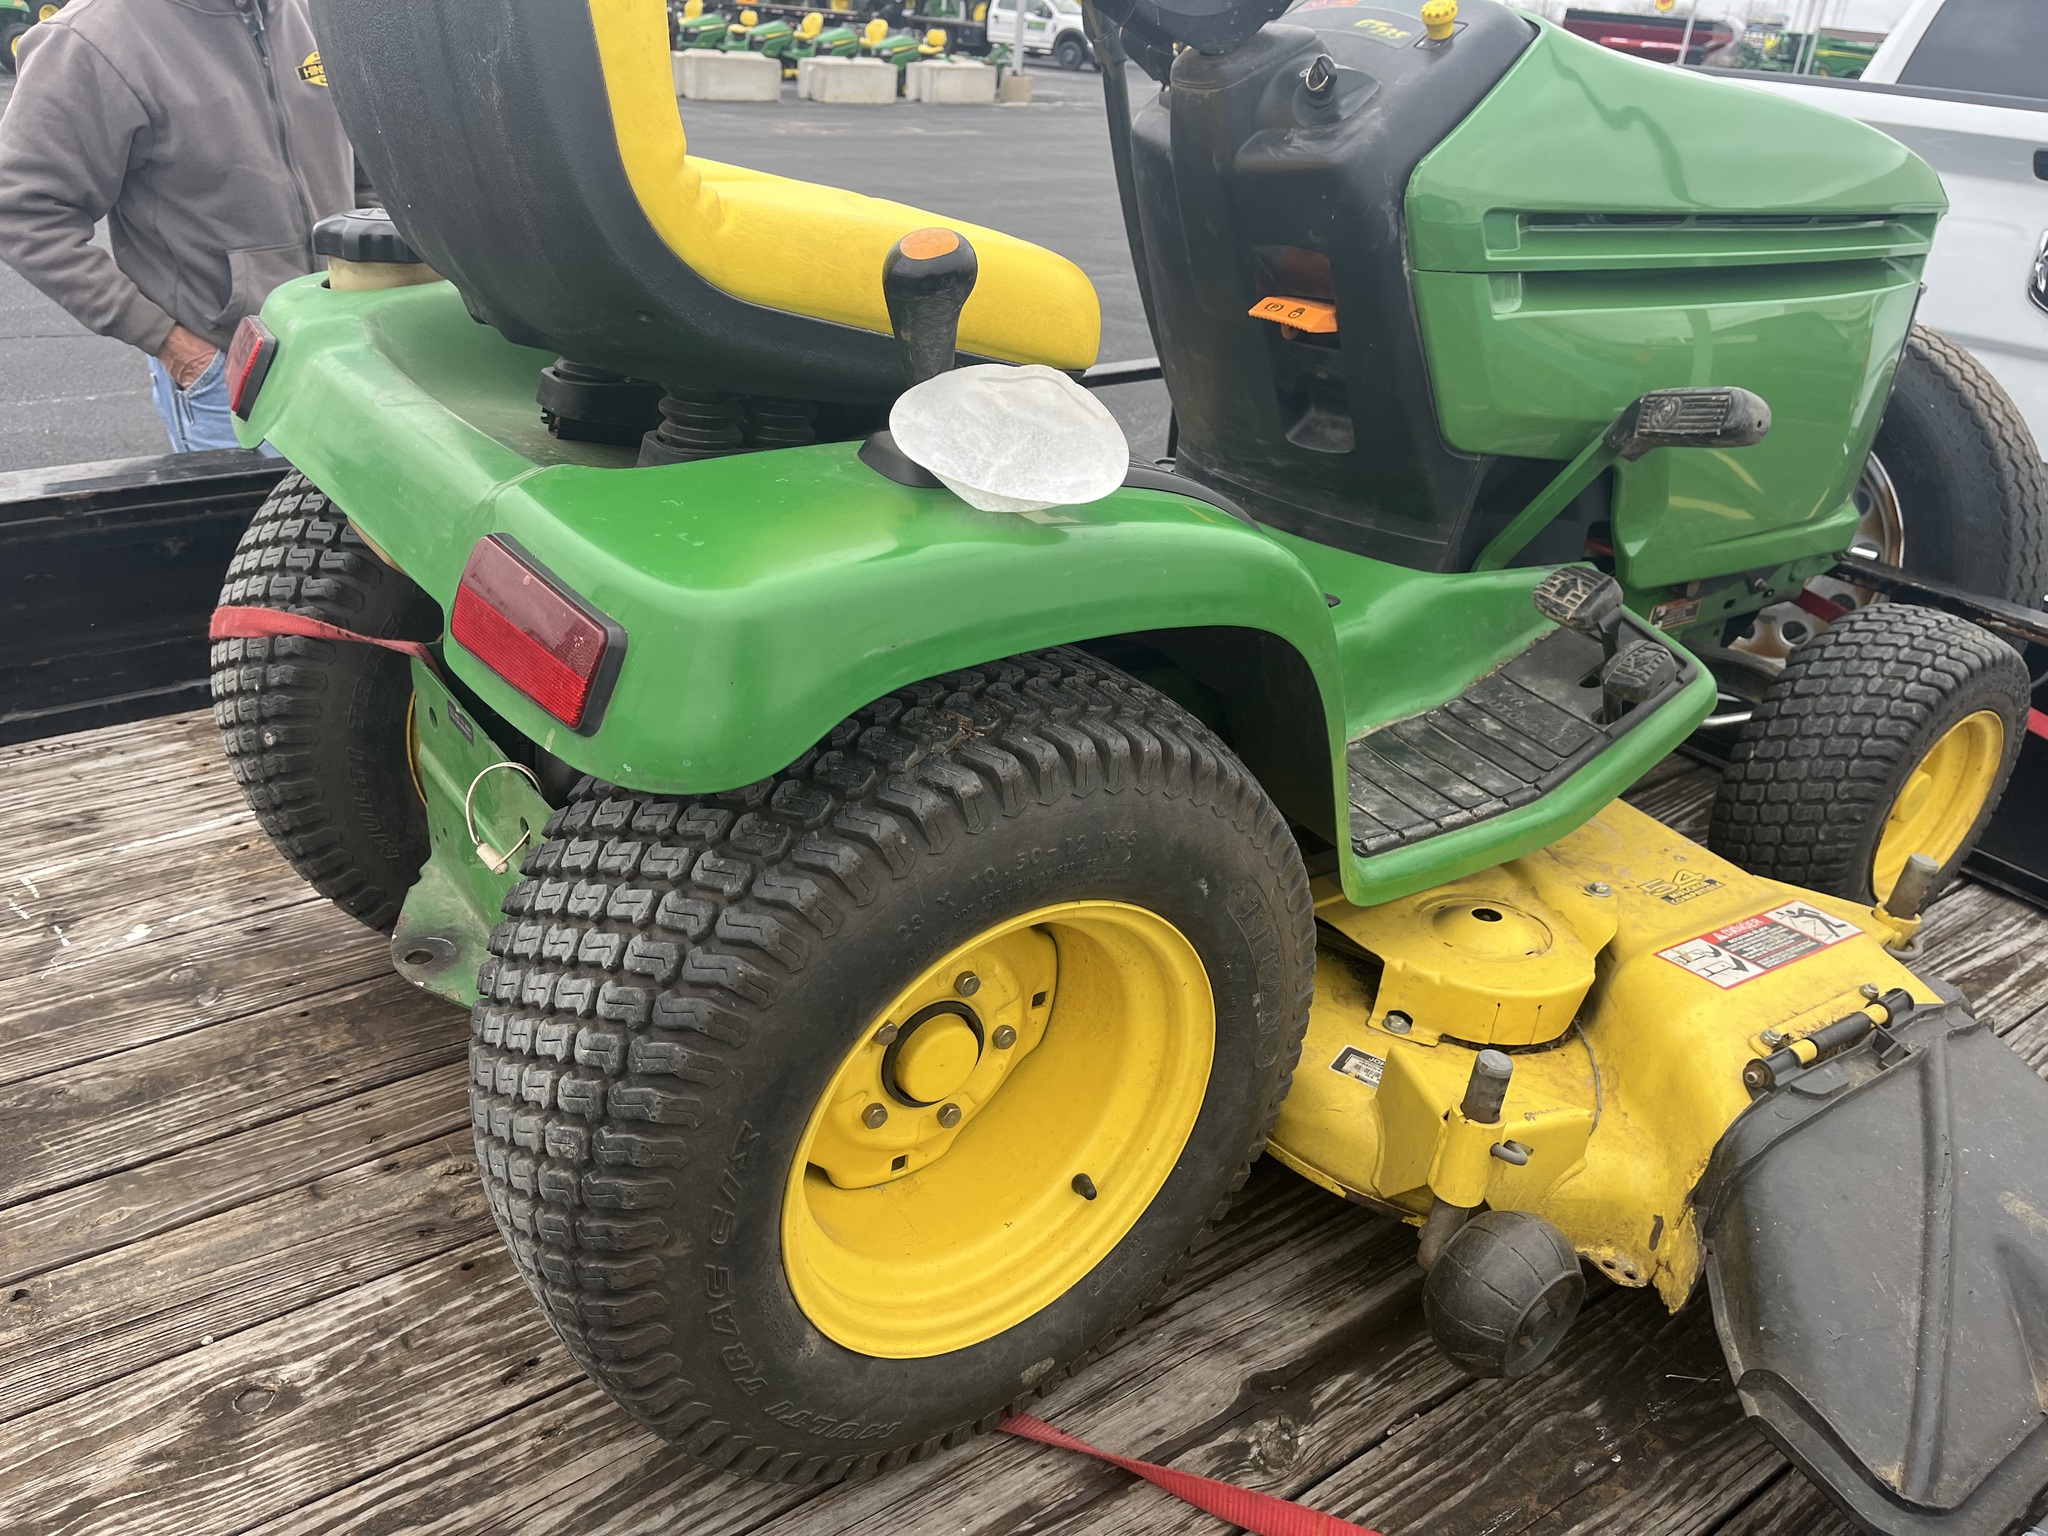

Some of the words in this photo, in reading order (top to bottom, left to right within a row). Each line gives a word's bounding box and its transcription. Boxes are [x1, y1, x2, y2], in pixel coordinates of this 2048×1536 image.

[1056, 857, 1099, 875] SERVICE
[1636, 868, 1706, 897] 54
[1723, 918, 1765, 937] DANGER
[1236, 894, 1283, 1036] TITAN
[703, 1262, 768, 1398] TRAC
[764, 1399, 903, 1440] MULTI
